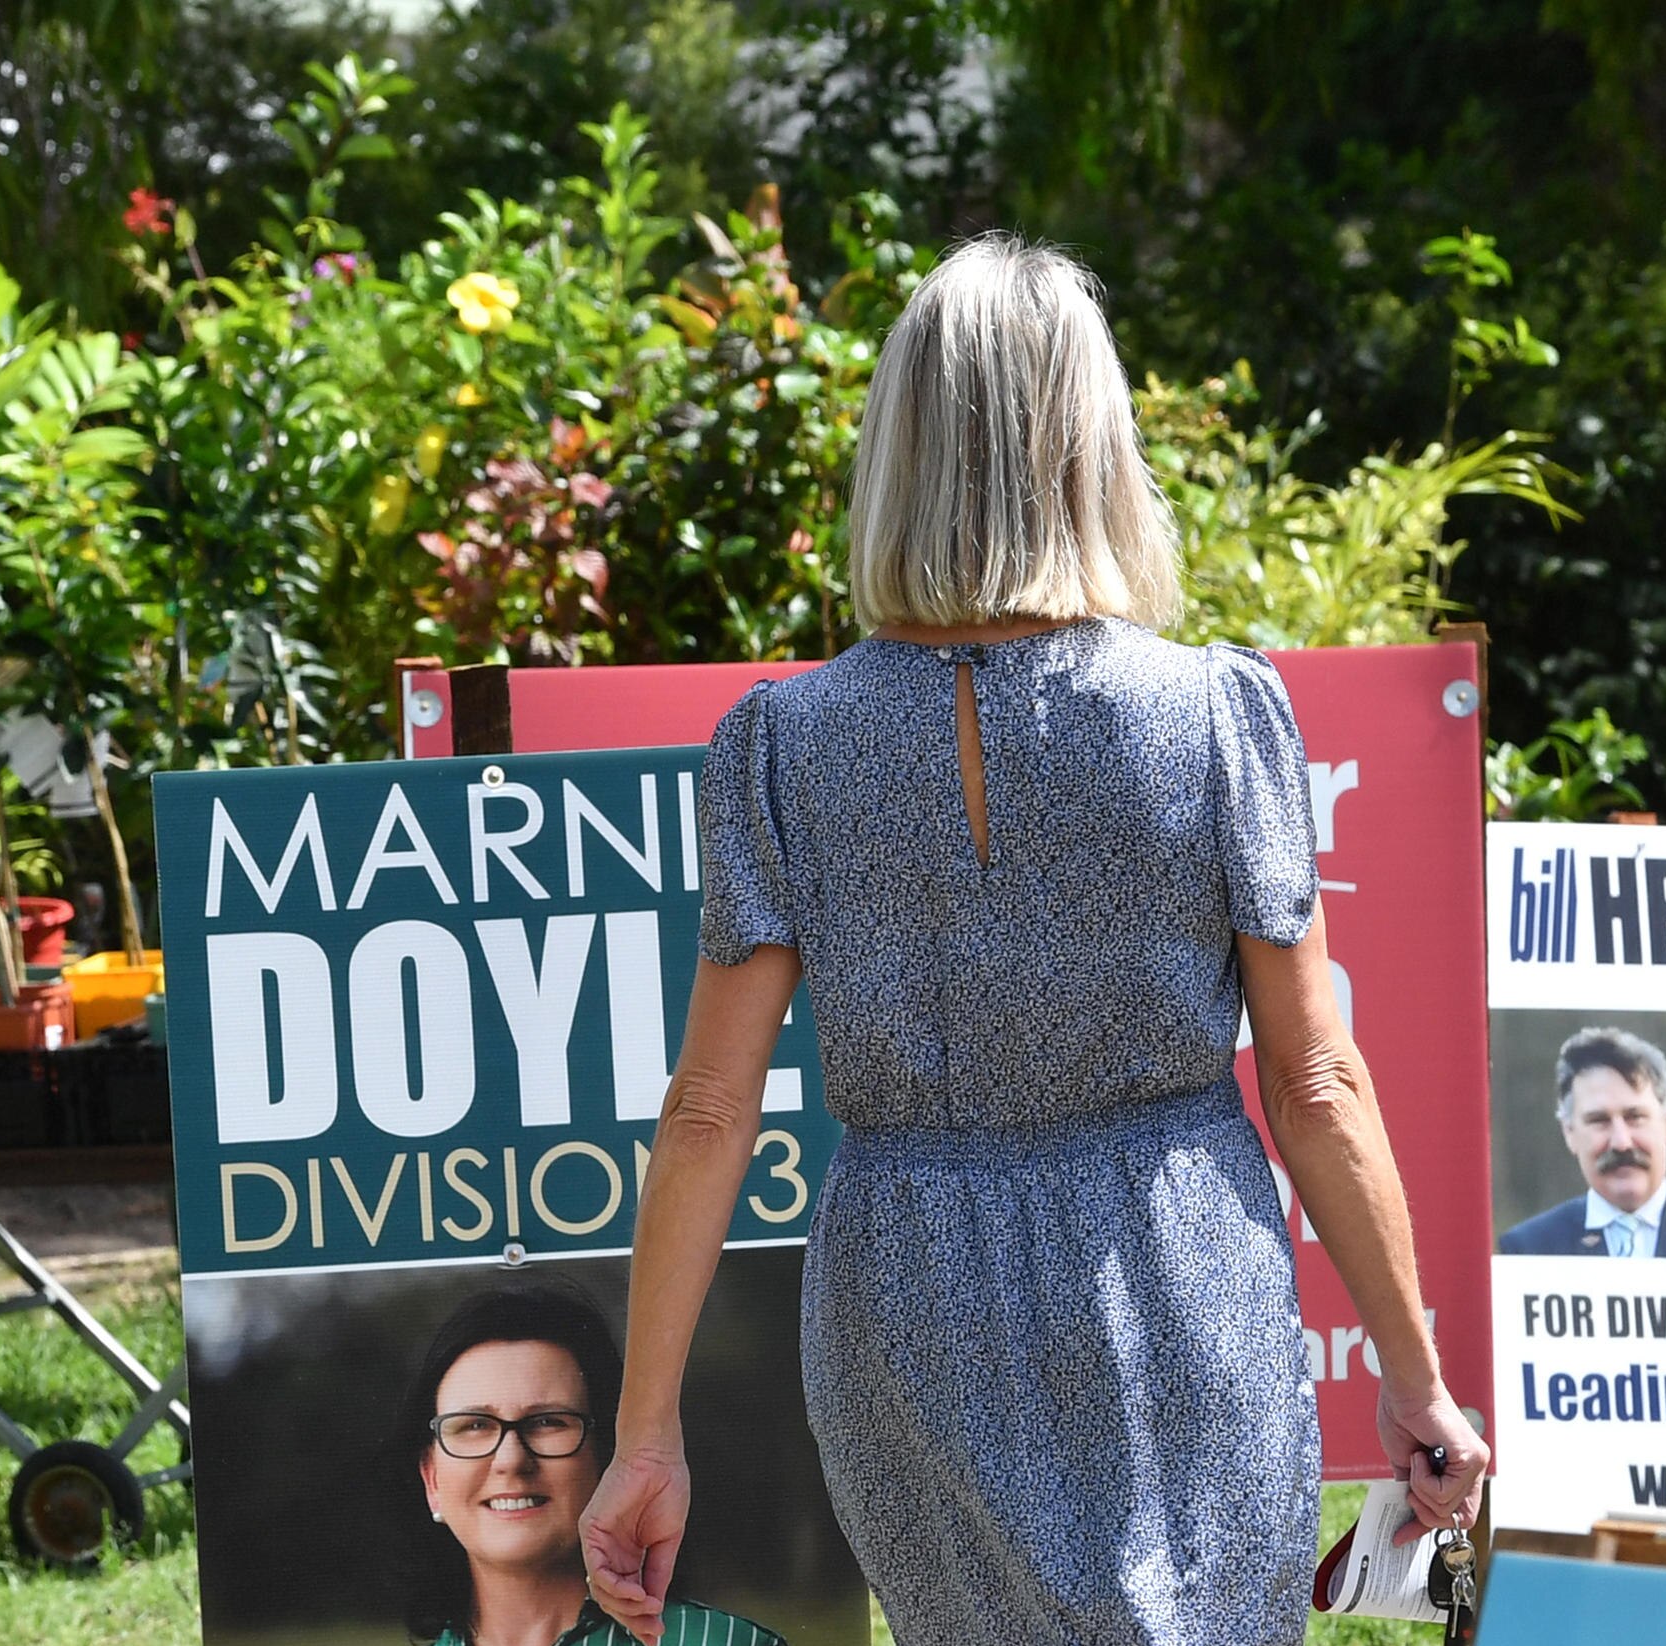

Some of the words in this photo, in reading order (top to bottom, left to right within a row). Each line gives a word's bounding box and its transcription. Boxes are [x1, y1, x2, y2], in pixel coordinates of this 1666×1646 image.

[204, 771, 701, 918] MARNI
[1509, 846, 1578, 963] bill
[747, 1129, 809, 1224] 3
[1522, 1293, 1595, 1338] FOR
